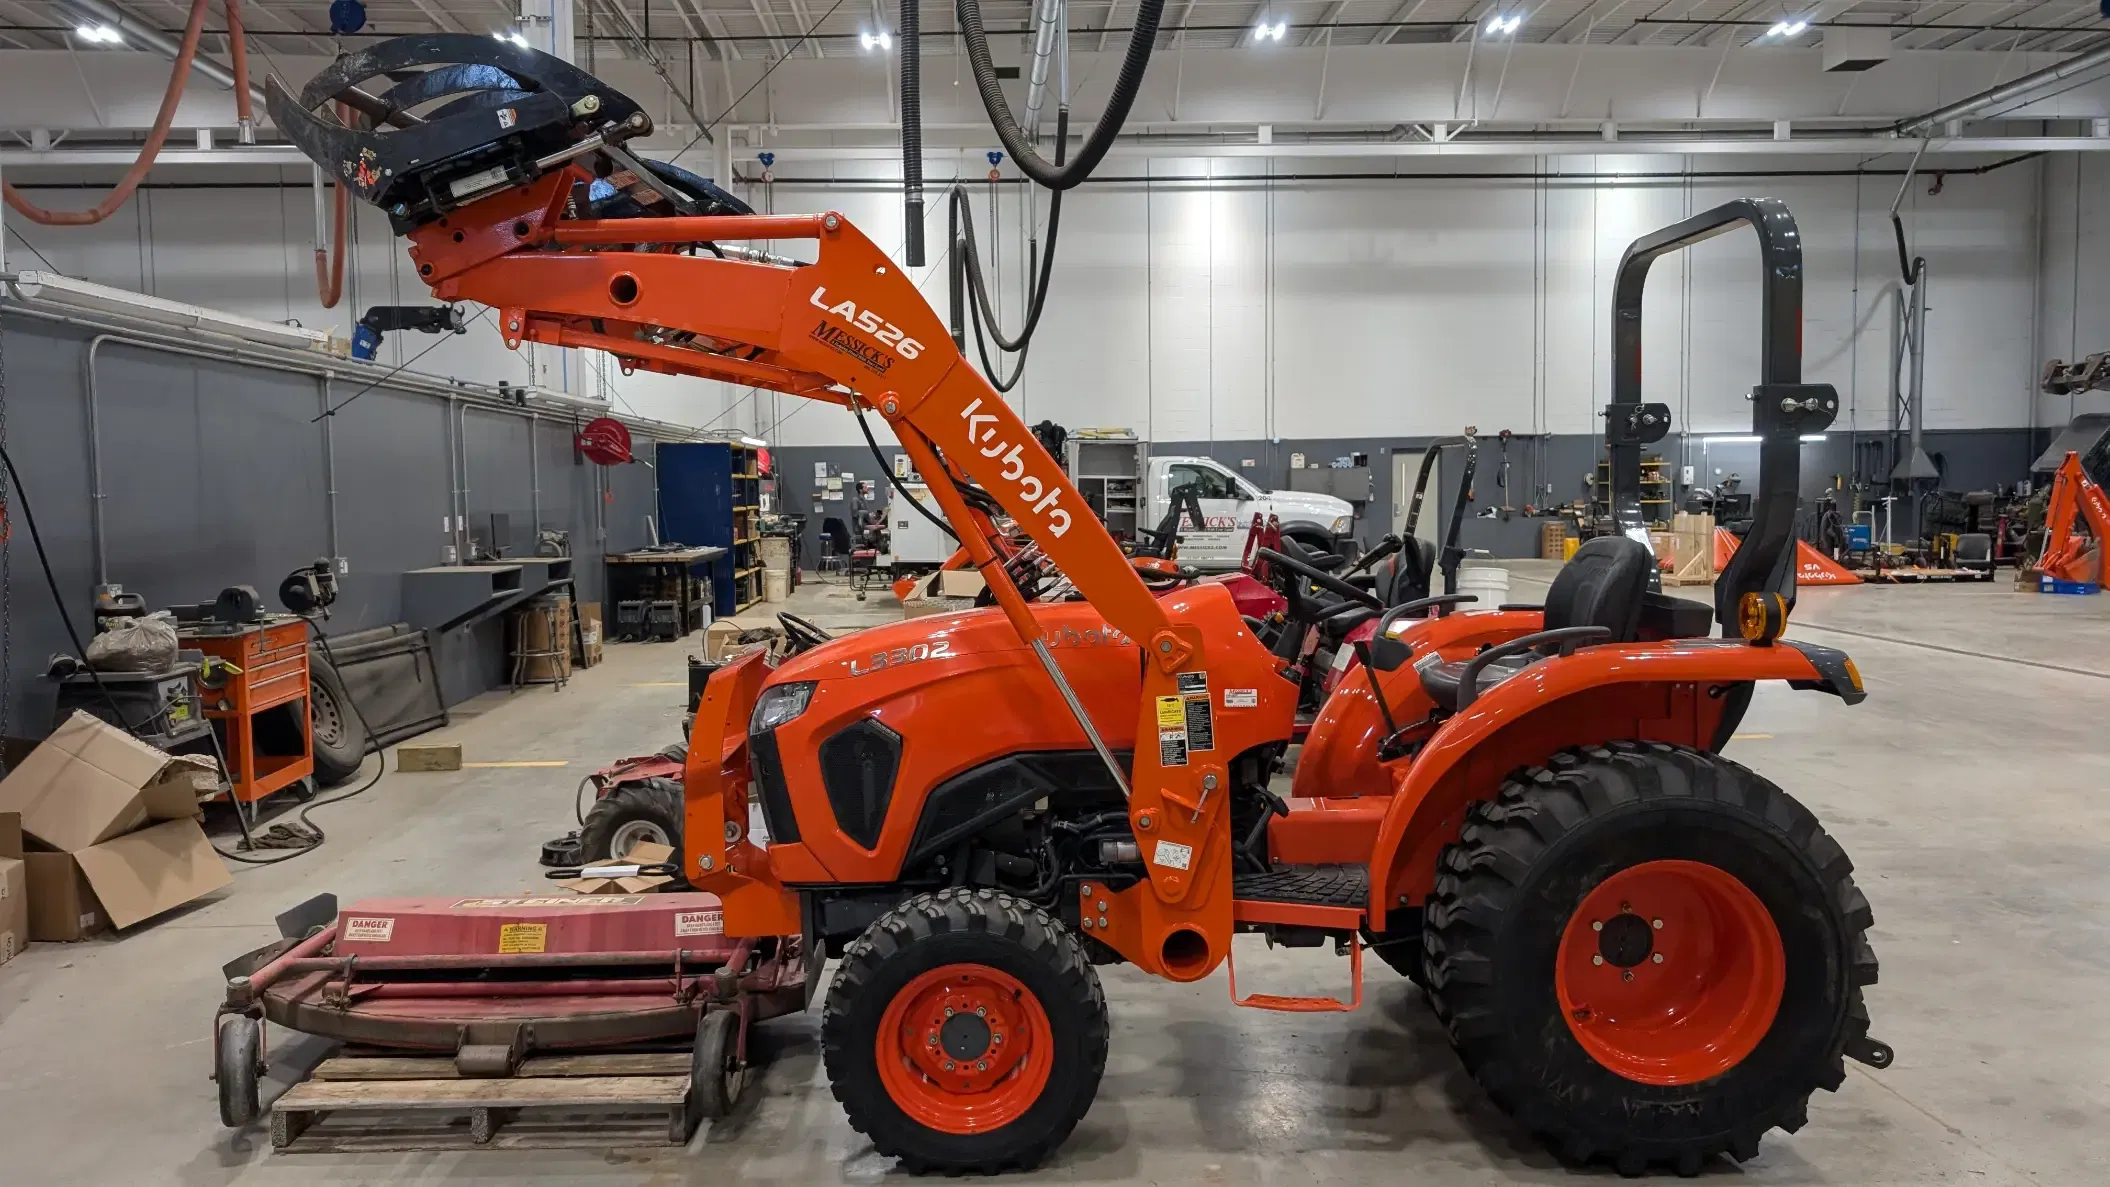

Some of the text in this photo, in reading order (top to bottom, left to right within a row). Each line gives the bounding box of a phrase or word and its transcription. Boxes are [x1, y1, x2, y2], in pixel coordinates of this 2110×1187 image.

[809, 286, 925, 360] LA526
[810, 320, 895, 369] MESSICK'S
[960, 397, 1072, 539] Kubota
[1041, 624, 1131, 646] ubota
[850, 641, 957, 676] L3302
[351, 919, 388, 928] DANGER
